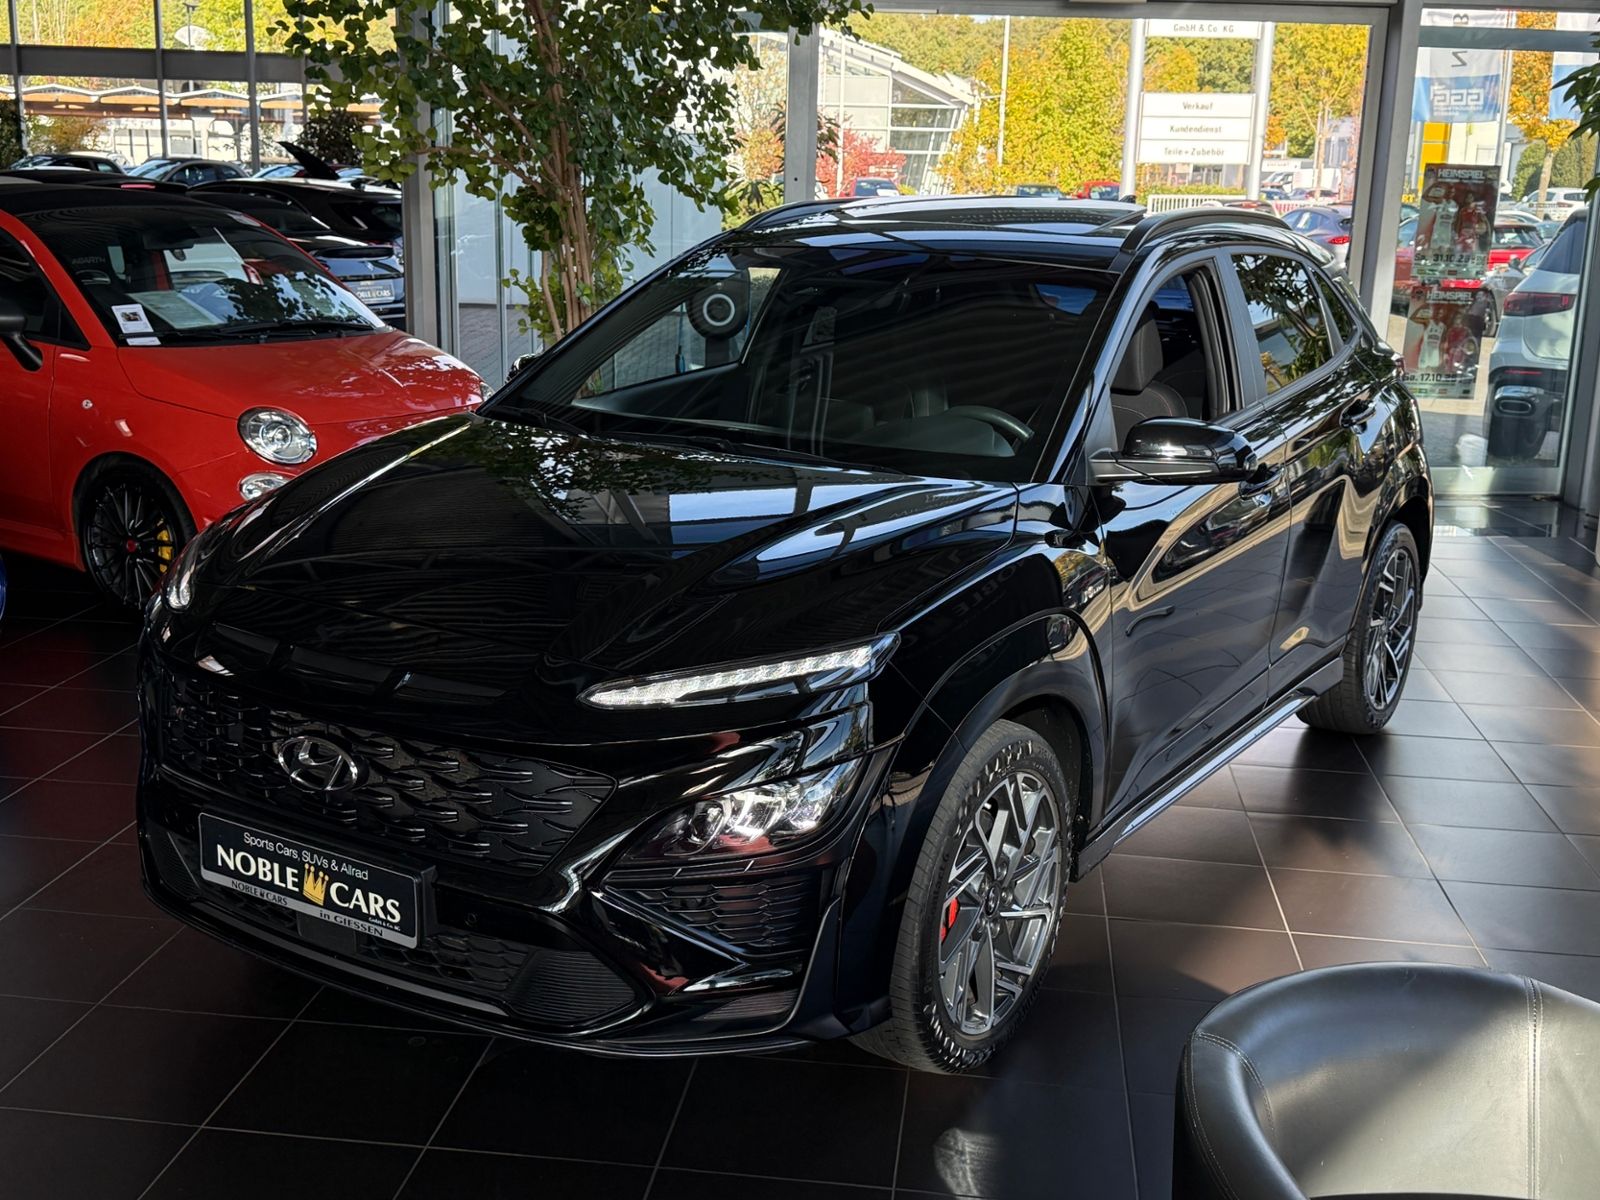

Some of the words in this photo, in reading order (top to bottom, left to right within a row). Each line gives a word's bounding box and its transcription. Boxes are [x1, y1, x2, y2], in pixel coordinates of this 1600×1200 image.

[1198, 24, 1205, 32] &
[1223, 25, 1235, 33] KG
[1182, 102, 1213, 111] Verkauf
[1169, 125, 1222, 133] Kundendienst
[1164, 147, 1183, 155] Teile
[1191, 147, 1225, 156] Zubehör
[1438, 168, 1485, 179] HEIMSPIEL
[1426, 290, 1474, 301] HEIMSPIEL
[243, 832, 275, 851] Sports
[275, 842, 301, 861] Cars,
[301, 850, 329, 869] SUVs
[330, 859, 339, 872] &
[340, 862, 369, 880] Allrad
[216, 843, 300, 892] NOBLE
[329, 881, 401, 923] CARS
[231, 880, 258, 896] NOBLE
[266, 891, 288, 906] CARS
[319, 909, 331, 920] in
[334, 913, 384, 937] GIESSEN
